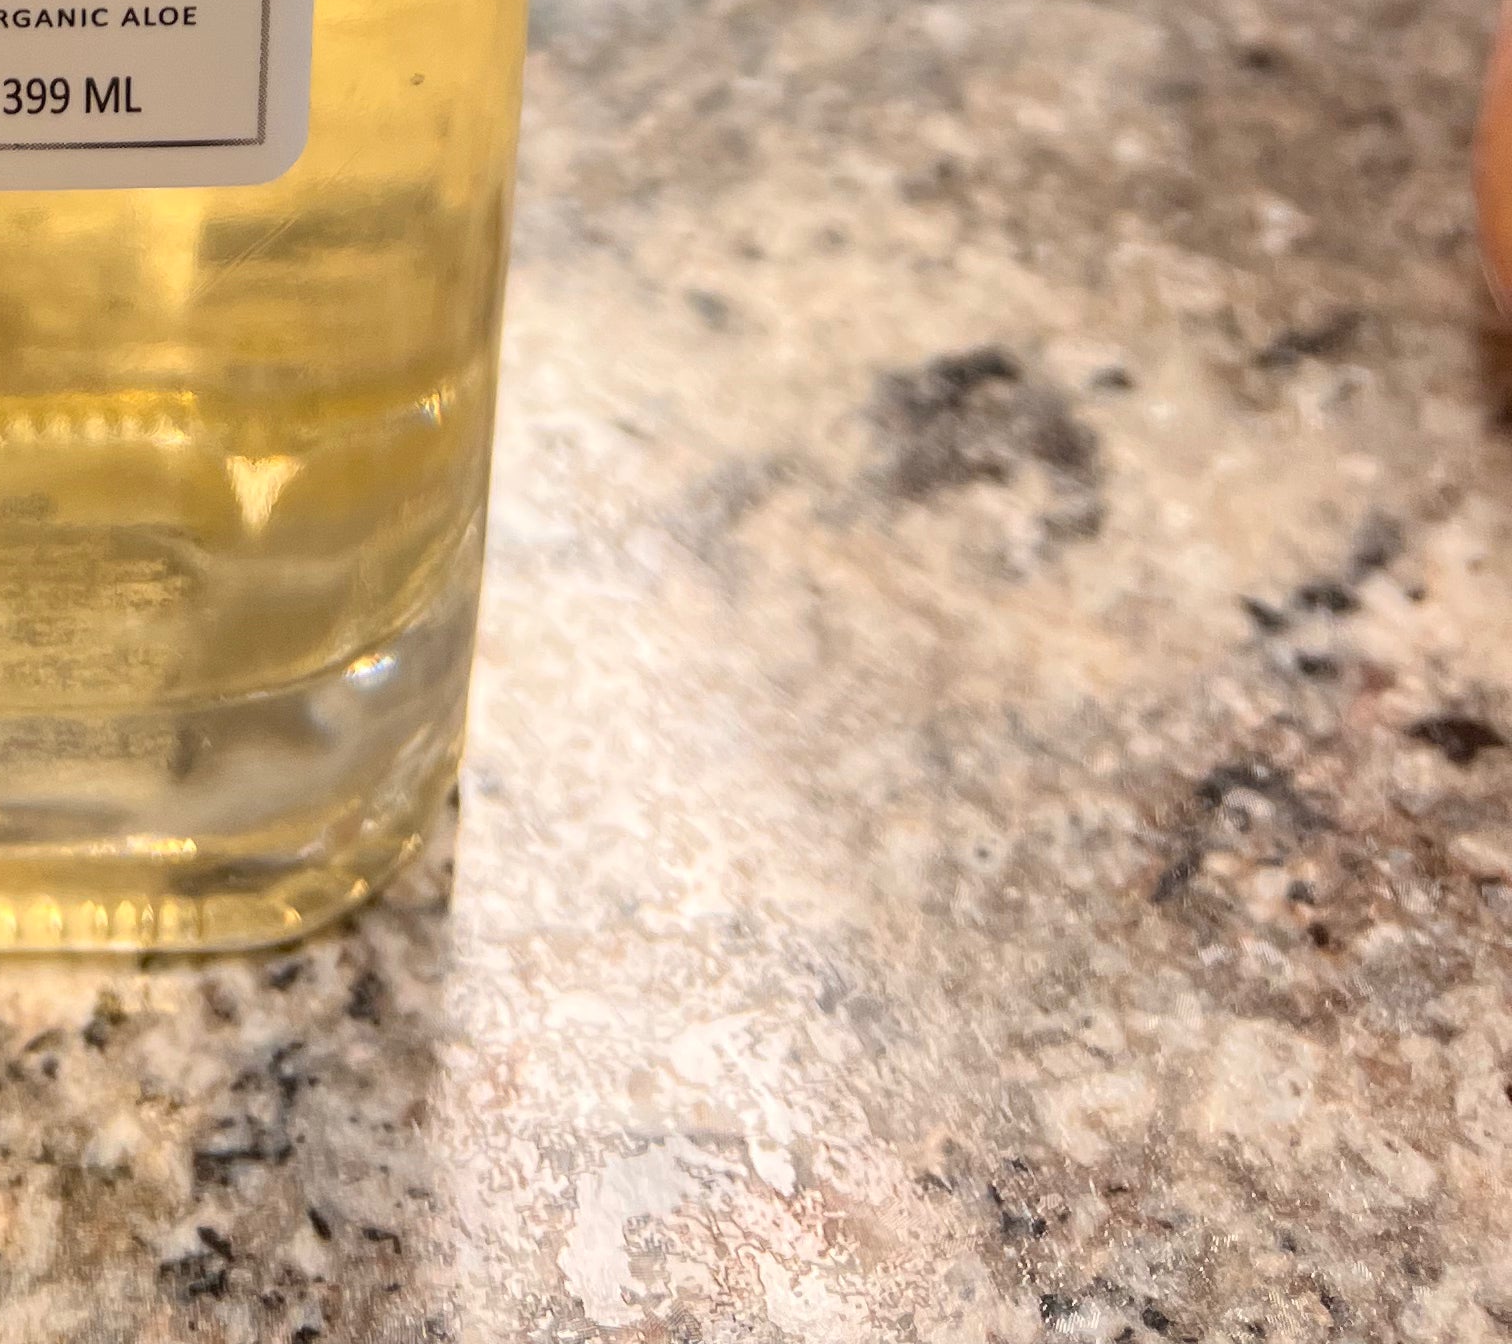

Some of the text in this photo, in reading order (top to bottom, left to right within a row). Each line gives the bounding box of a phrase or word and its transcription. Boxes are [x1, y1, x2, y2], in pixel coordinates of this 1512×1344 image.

[121, 6, 197, 28] ALOE
[3, 77, 71, 115] 399
[85, 75, 142, 114] ML
